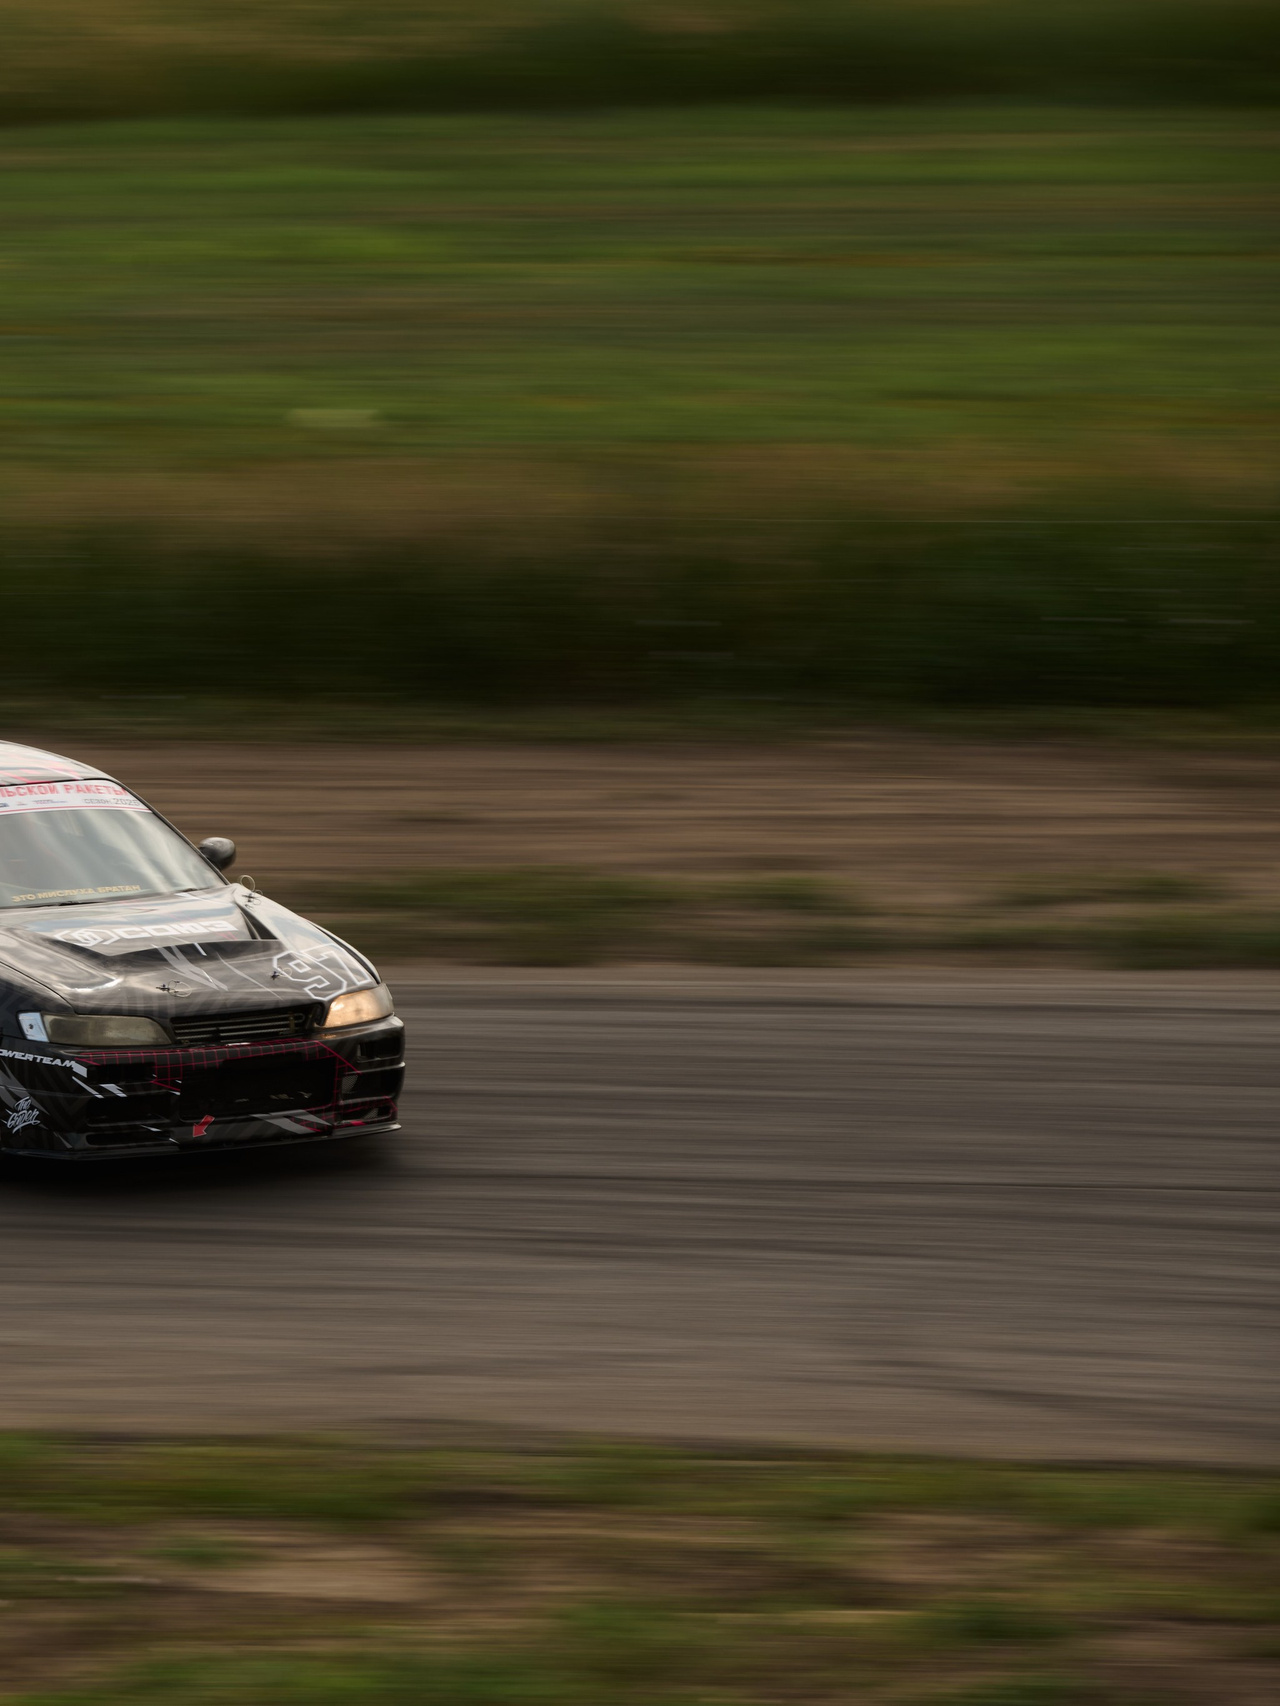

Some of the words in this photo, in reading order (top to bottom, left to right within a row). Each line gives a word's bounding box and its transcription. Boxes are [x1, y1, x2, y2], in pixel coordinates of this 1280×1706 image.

[64, 784, 129, 796] РАКЕТЫ
[11, 893, 36, 903] ЭТО
[273, 943, 372, 1001] 97
